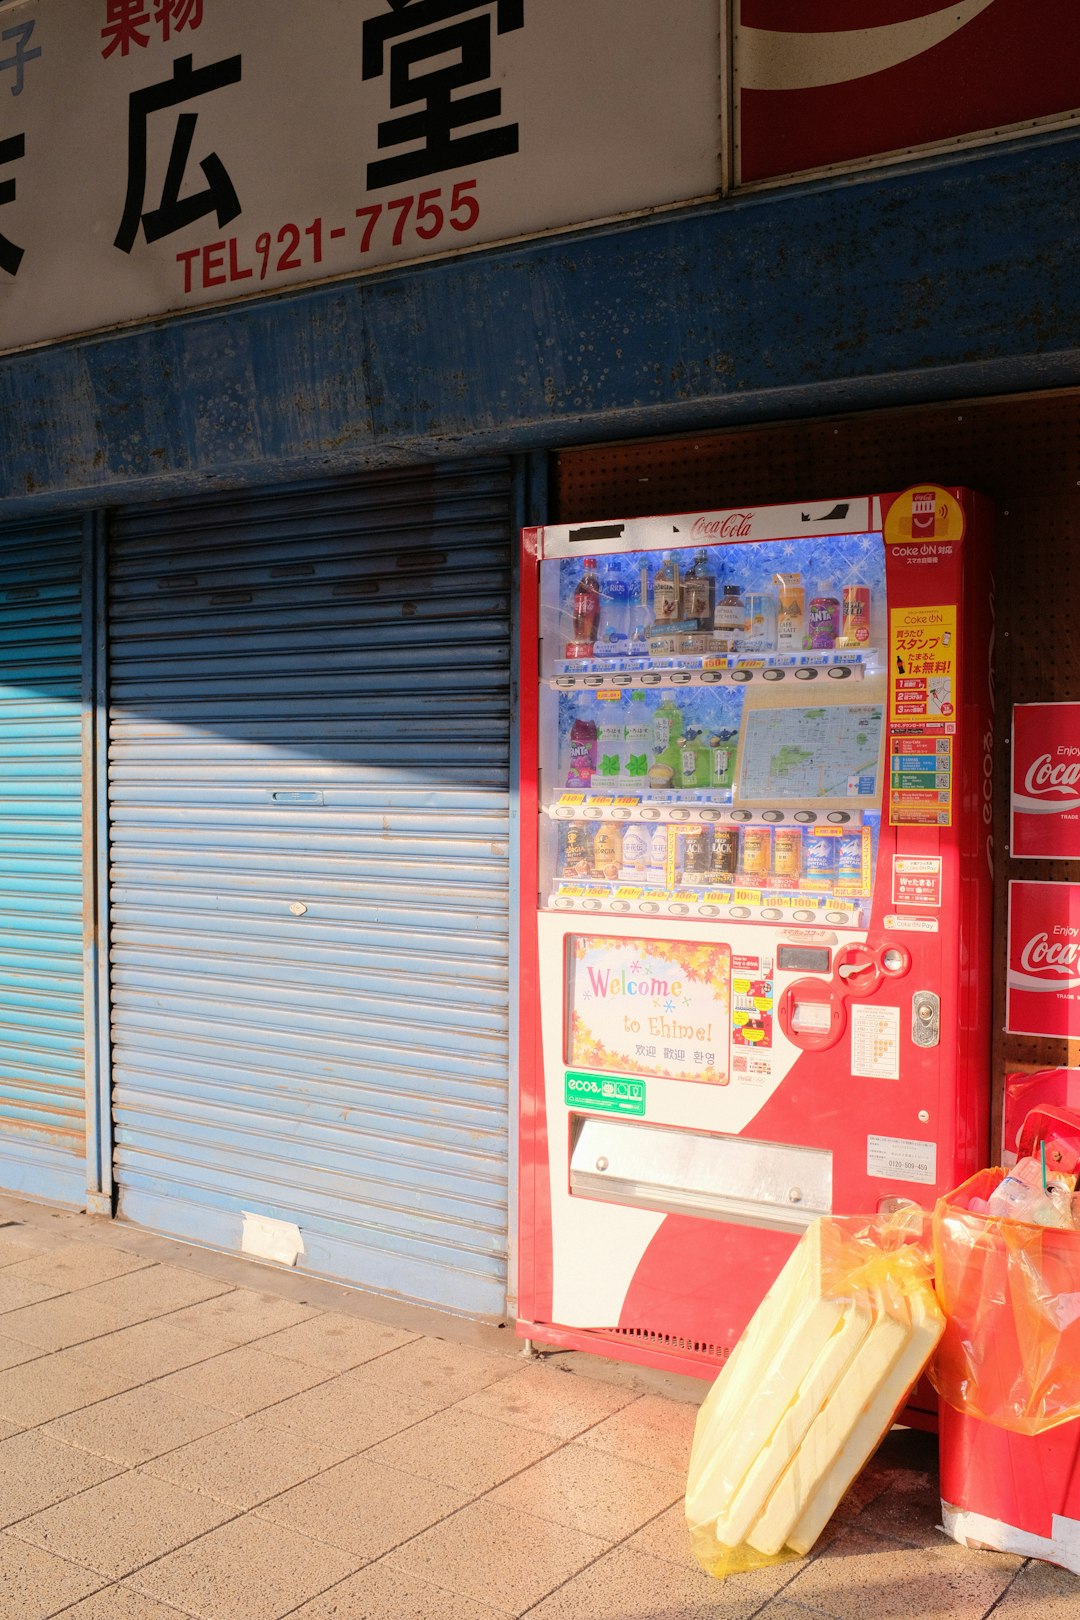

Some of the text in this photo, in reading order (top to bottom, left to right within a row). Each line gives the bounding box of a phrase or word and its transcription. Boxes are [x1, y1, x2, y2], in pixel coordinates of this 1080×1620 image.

[101, 0, 203, 59] 果物
[892, 547, 919, 556] Coke
[904, 615, 927, 624] Coke
[896, 629, 924, 638] 買うたび
[896, 637, 940, 651] スタンプ
[908, 653, 935, 661] たまると
[897, 692, 904, 700] 2
[897, 705, 904, 713] 3
[1057, 746, 1080, 757] Enjoy
[1024, 753, 1080, 794] Coca
[685, 843, 705, 853] ACK
[736, 891, 759, 901] 100円
[794, 898, 817, 907] 100円
[1053, 925, 1079, 937] Enjoy
[1021, 932, 1080, 975] Coca
[587, 966, 683, 998] Welcome
[624, 1014, 713, 1042] to Ehime!
[635, 1044, 686, 1062] 欢迎 歡迎
[693, 1050, 716, 1066] 환영
